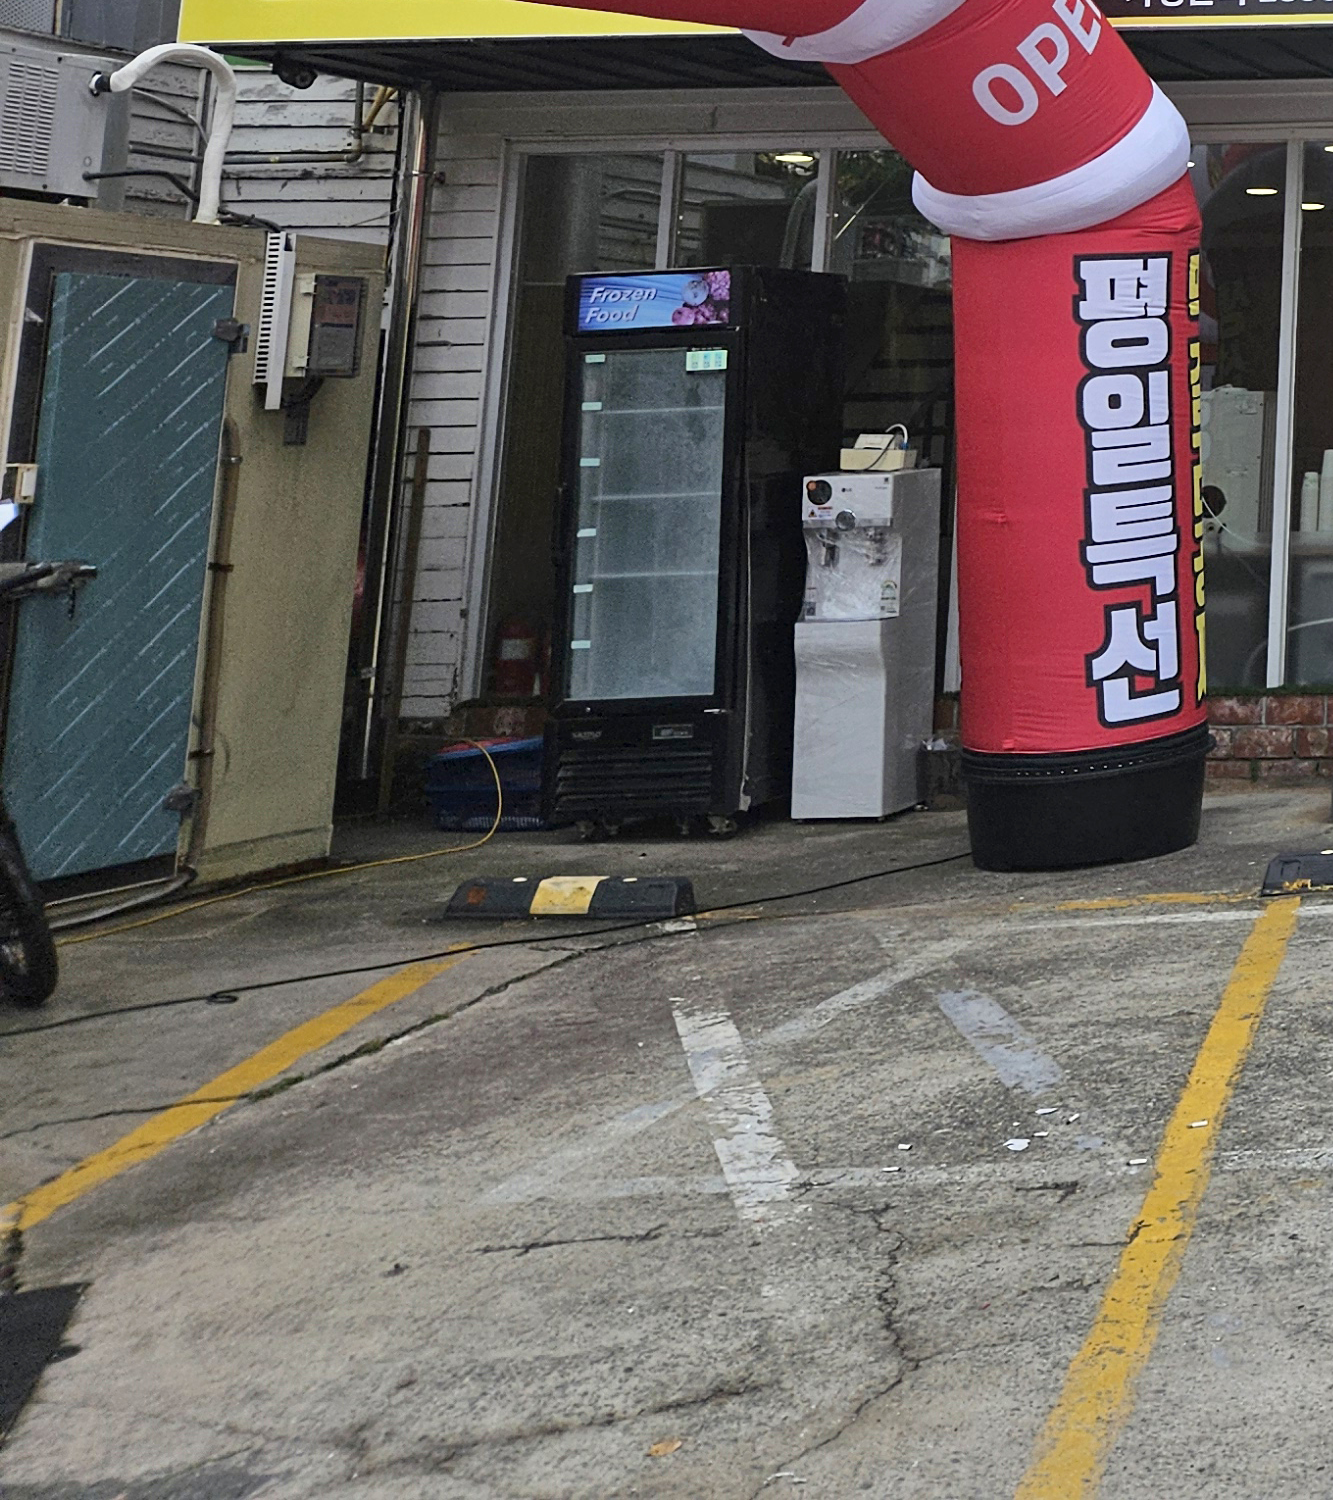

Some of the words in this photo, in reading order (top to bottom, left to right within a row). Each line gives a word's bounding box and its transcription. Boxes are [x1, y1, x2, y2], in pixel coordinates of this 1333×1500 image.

[590, 285, 657, 303] Frozen
[585, 305, 638, 323] Food
[1079, 257, 1181, 725] 평일특선
